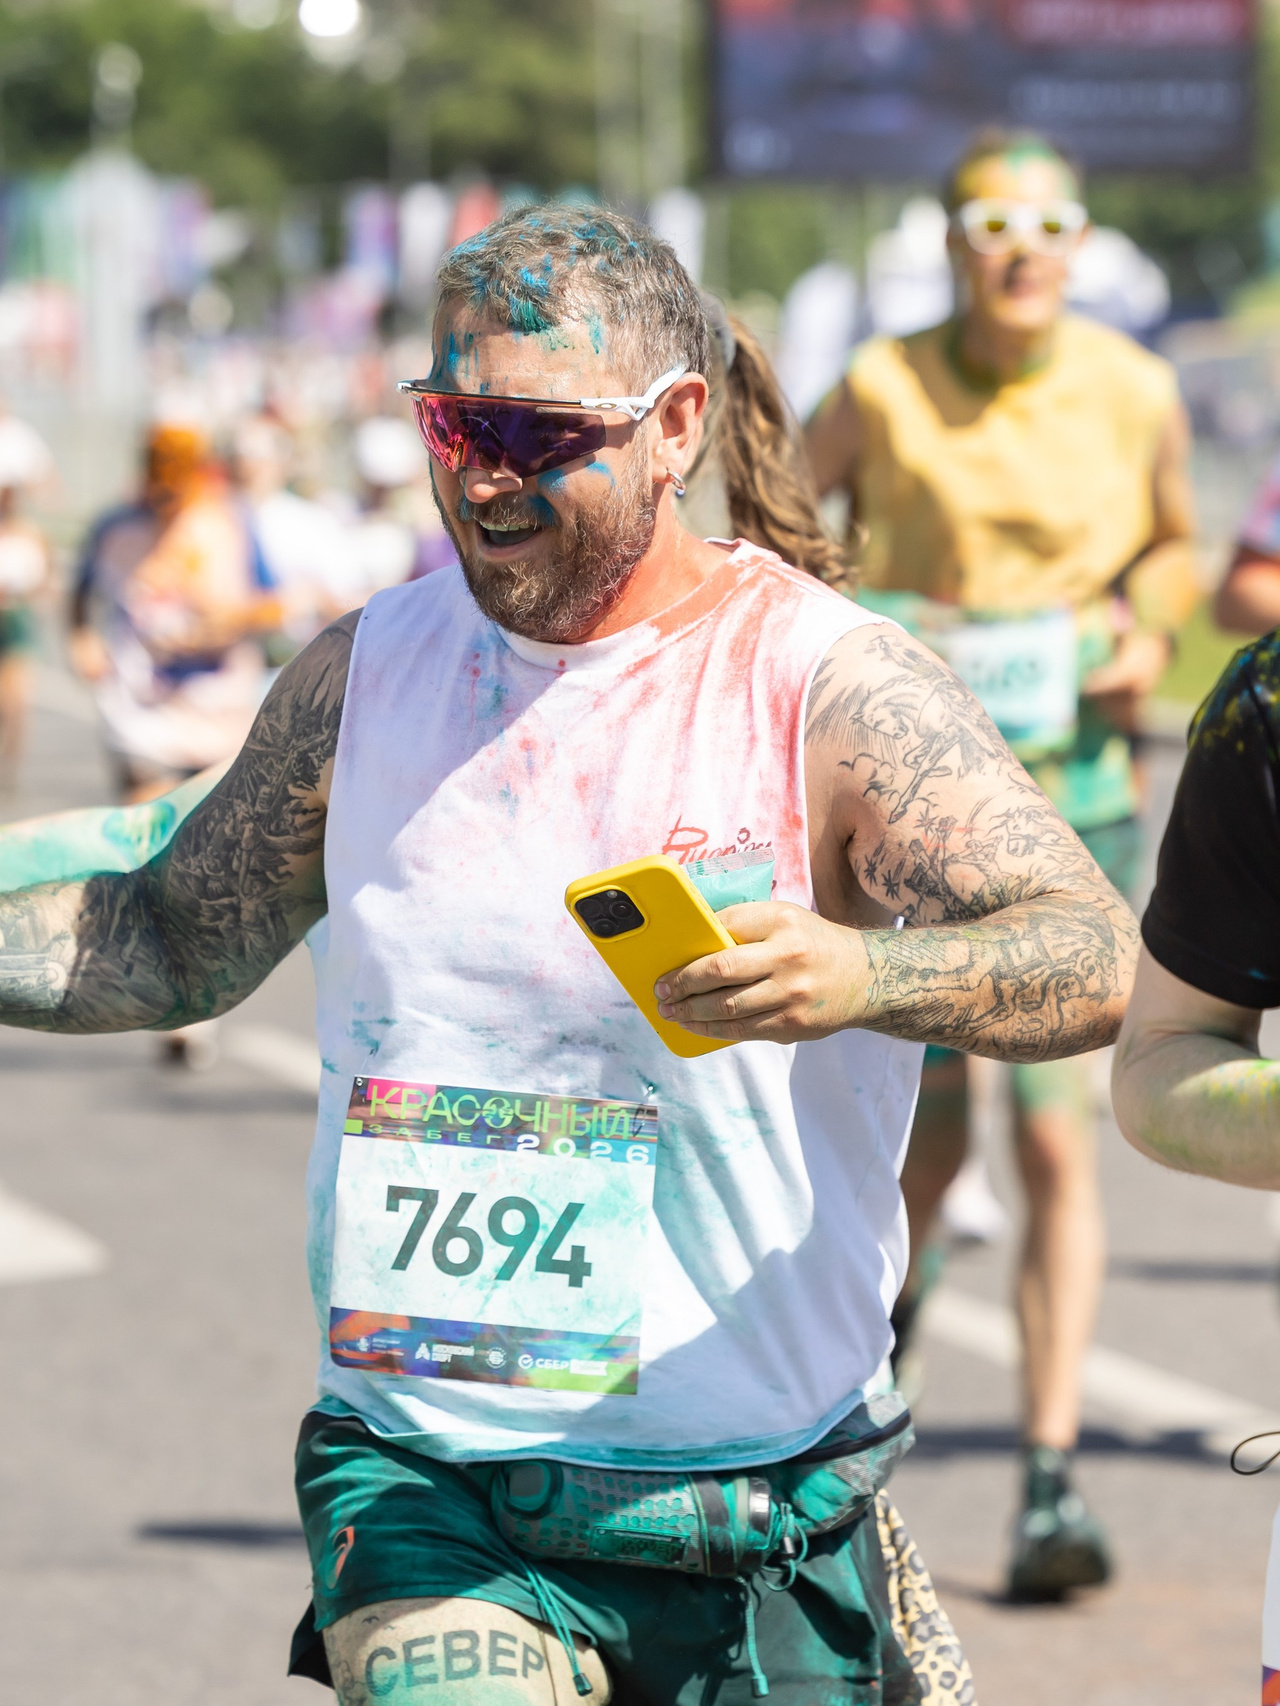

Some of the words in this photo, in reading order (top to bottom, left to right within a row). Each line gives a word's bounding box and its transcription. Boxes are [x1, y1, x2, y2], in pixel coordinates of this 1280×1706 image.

[369, 1085, 630, 1140] КРАСОЧНЫЙ
[368, 1124, 502, 1146] ЗАБЕГ
[516, 1134, 650, 1165] 2026
[385, 1185, 592, 1288] 7694
[365, 1629, 545, 1697] СЕВЕР
